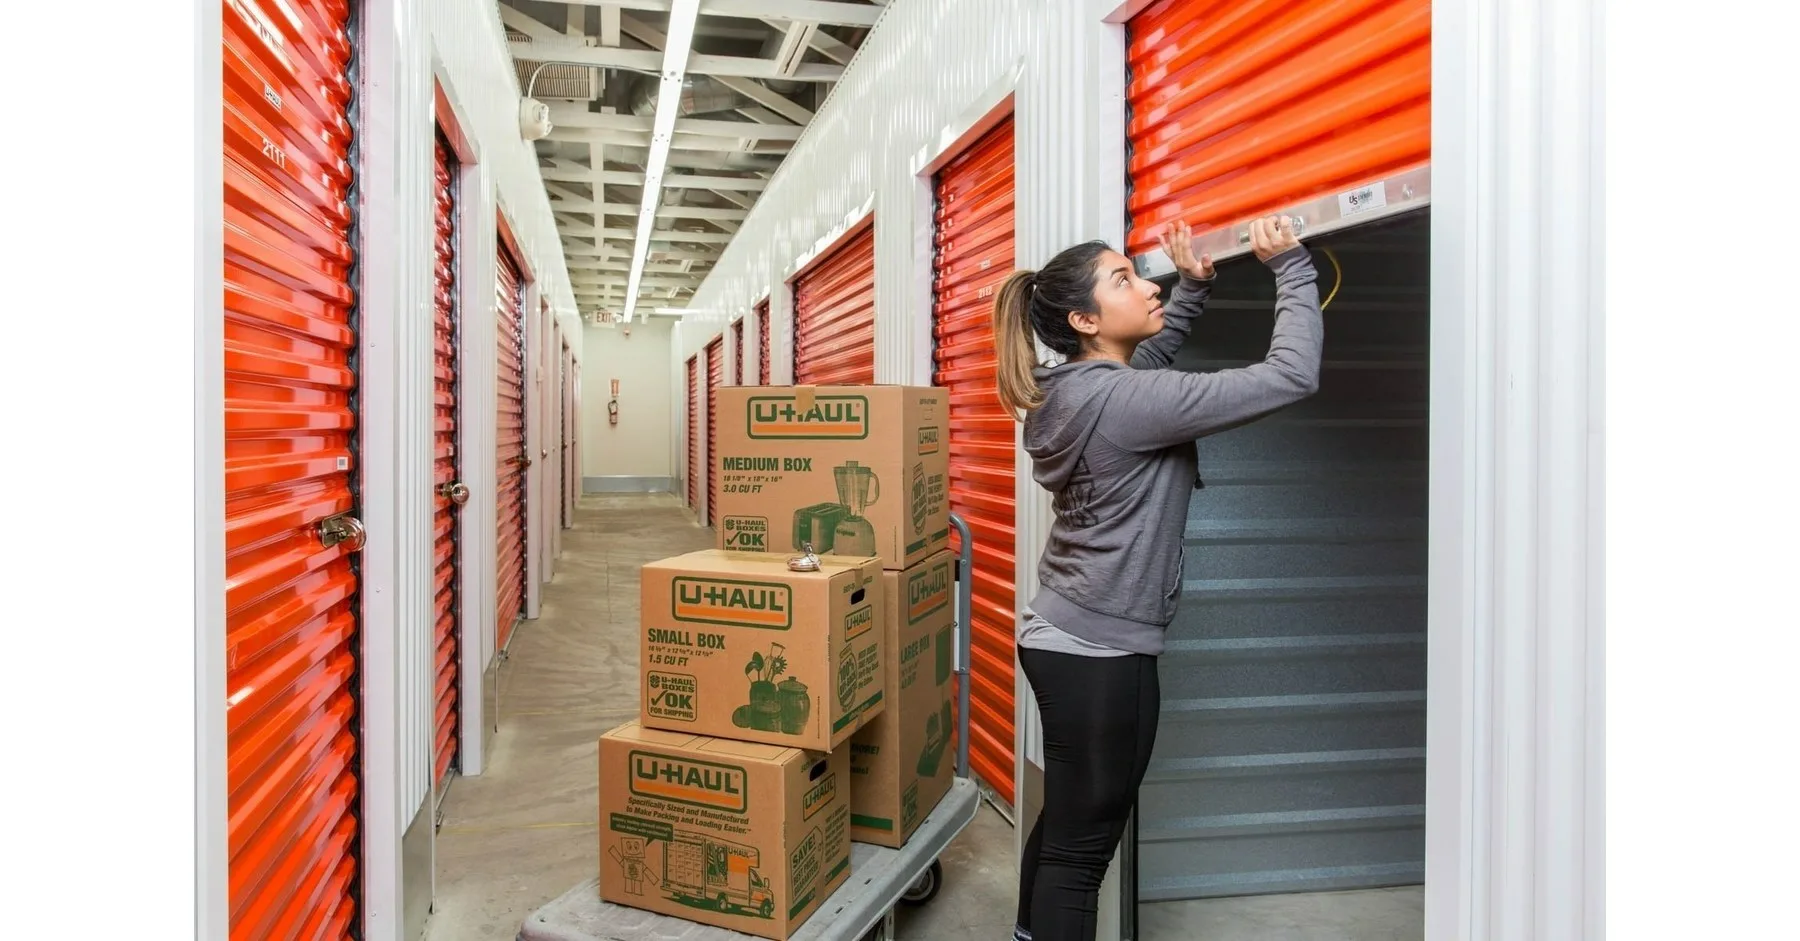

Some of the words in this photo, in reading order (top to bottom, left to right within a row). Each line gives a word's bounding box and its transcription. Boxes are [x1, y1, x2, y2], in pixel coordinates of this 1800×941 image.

[262, 137, 287, 169] 2111
[597, 312, 612, 323] EXIT
[723, 457, 779, 471] MEDIUM
[783, 457, 812, 472] BOX
[723, 484, 737, 493] 3.0
[738, 484, 751, 493] CU
[751, 484, 763, 493] FT
[739, 533, 765, 546] OK
[680, 584, 784, 611] U-HAUL
[648, 628, 693, 646] SMALL
[697, 632, 726, 649] BOX
[649, 653, 662, 664] 1.5
[664, 655, 676, 665] CU
[677, 656, 689, 667] FT
[661, 676, 695, 686] U-HAUL
[661, 684, 695, 693] BOXES
[665, 692, 693, 710] OK
[650, 707, 663, 715] FOR
[663, 708, 694, 719] SHIPPING
[637, 758, 740, 794] U-HAUL
[628, 796, 665, 811] Specifically
[666, 803, 686, 813] Sized
[686, 806, 700, 816] and
[701, 810, 749, 825] Manufactured
[634, 807, 652, 816] Make
[653, 810, 680, 823] Packing
[680, 816, 694, 825] and
[695, 818, 722, 831] Loading
[792, 832, 816, 869] SAVE!
